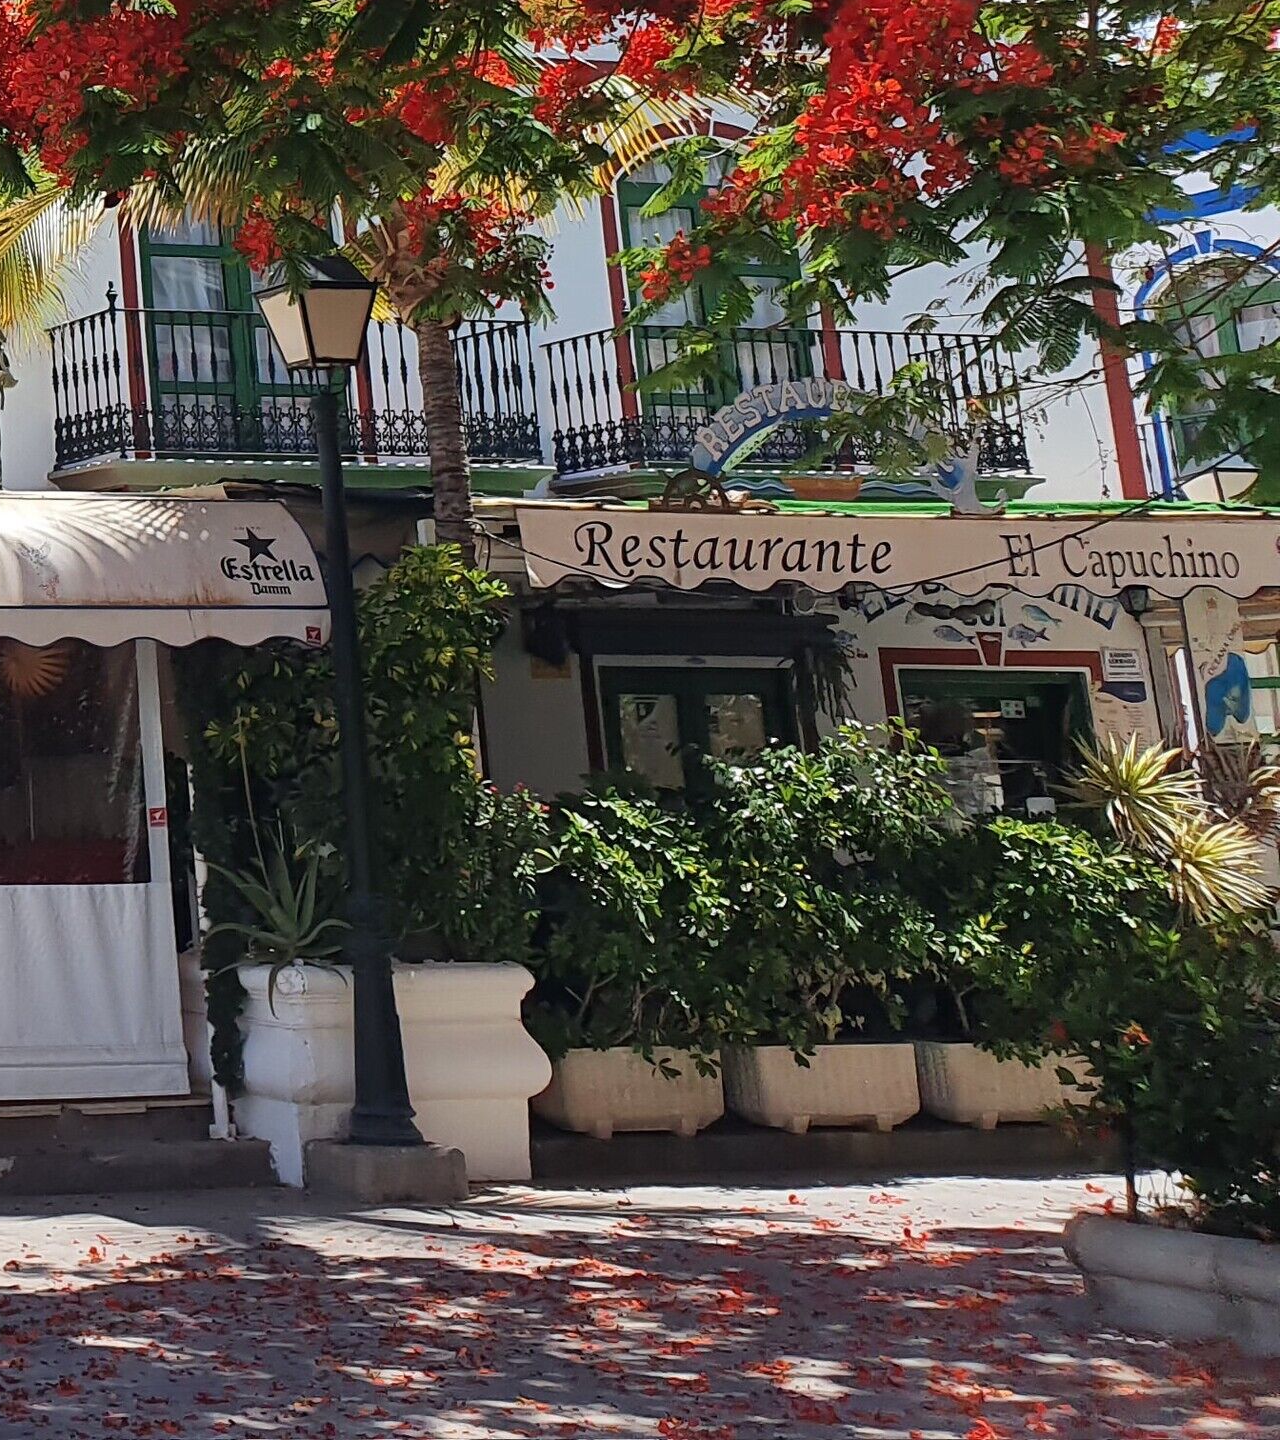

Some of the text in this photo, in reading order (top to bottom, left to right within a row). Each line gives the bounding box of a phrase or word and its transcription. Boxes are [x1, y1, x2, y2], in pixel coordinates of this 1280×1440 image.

[220, 556, 315, 581] Estrella
[574, 521, 893, 578] Restaurante
[1000, 533, 1240, 589] El Capuchino
[250, 582, 292, 595] Damm
